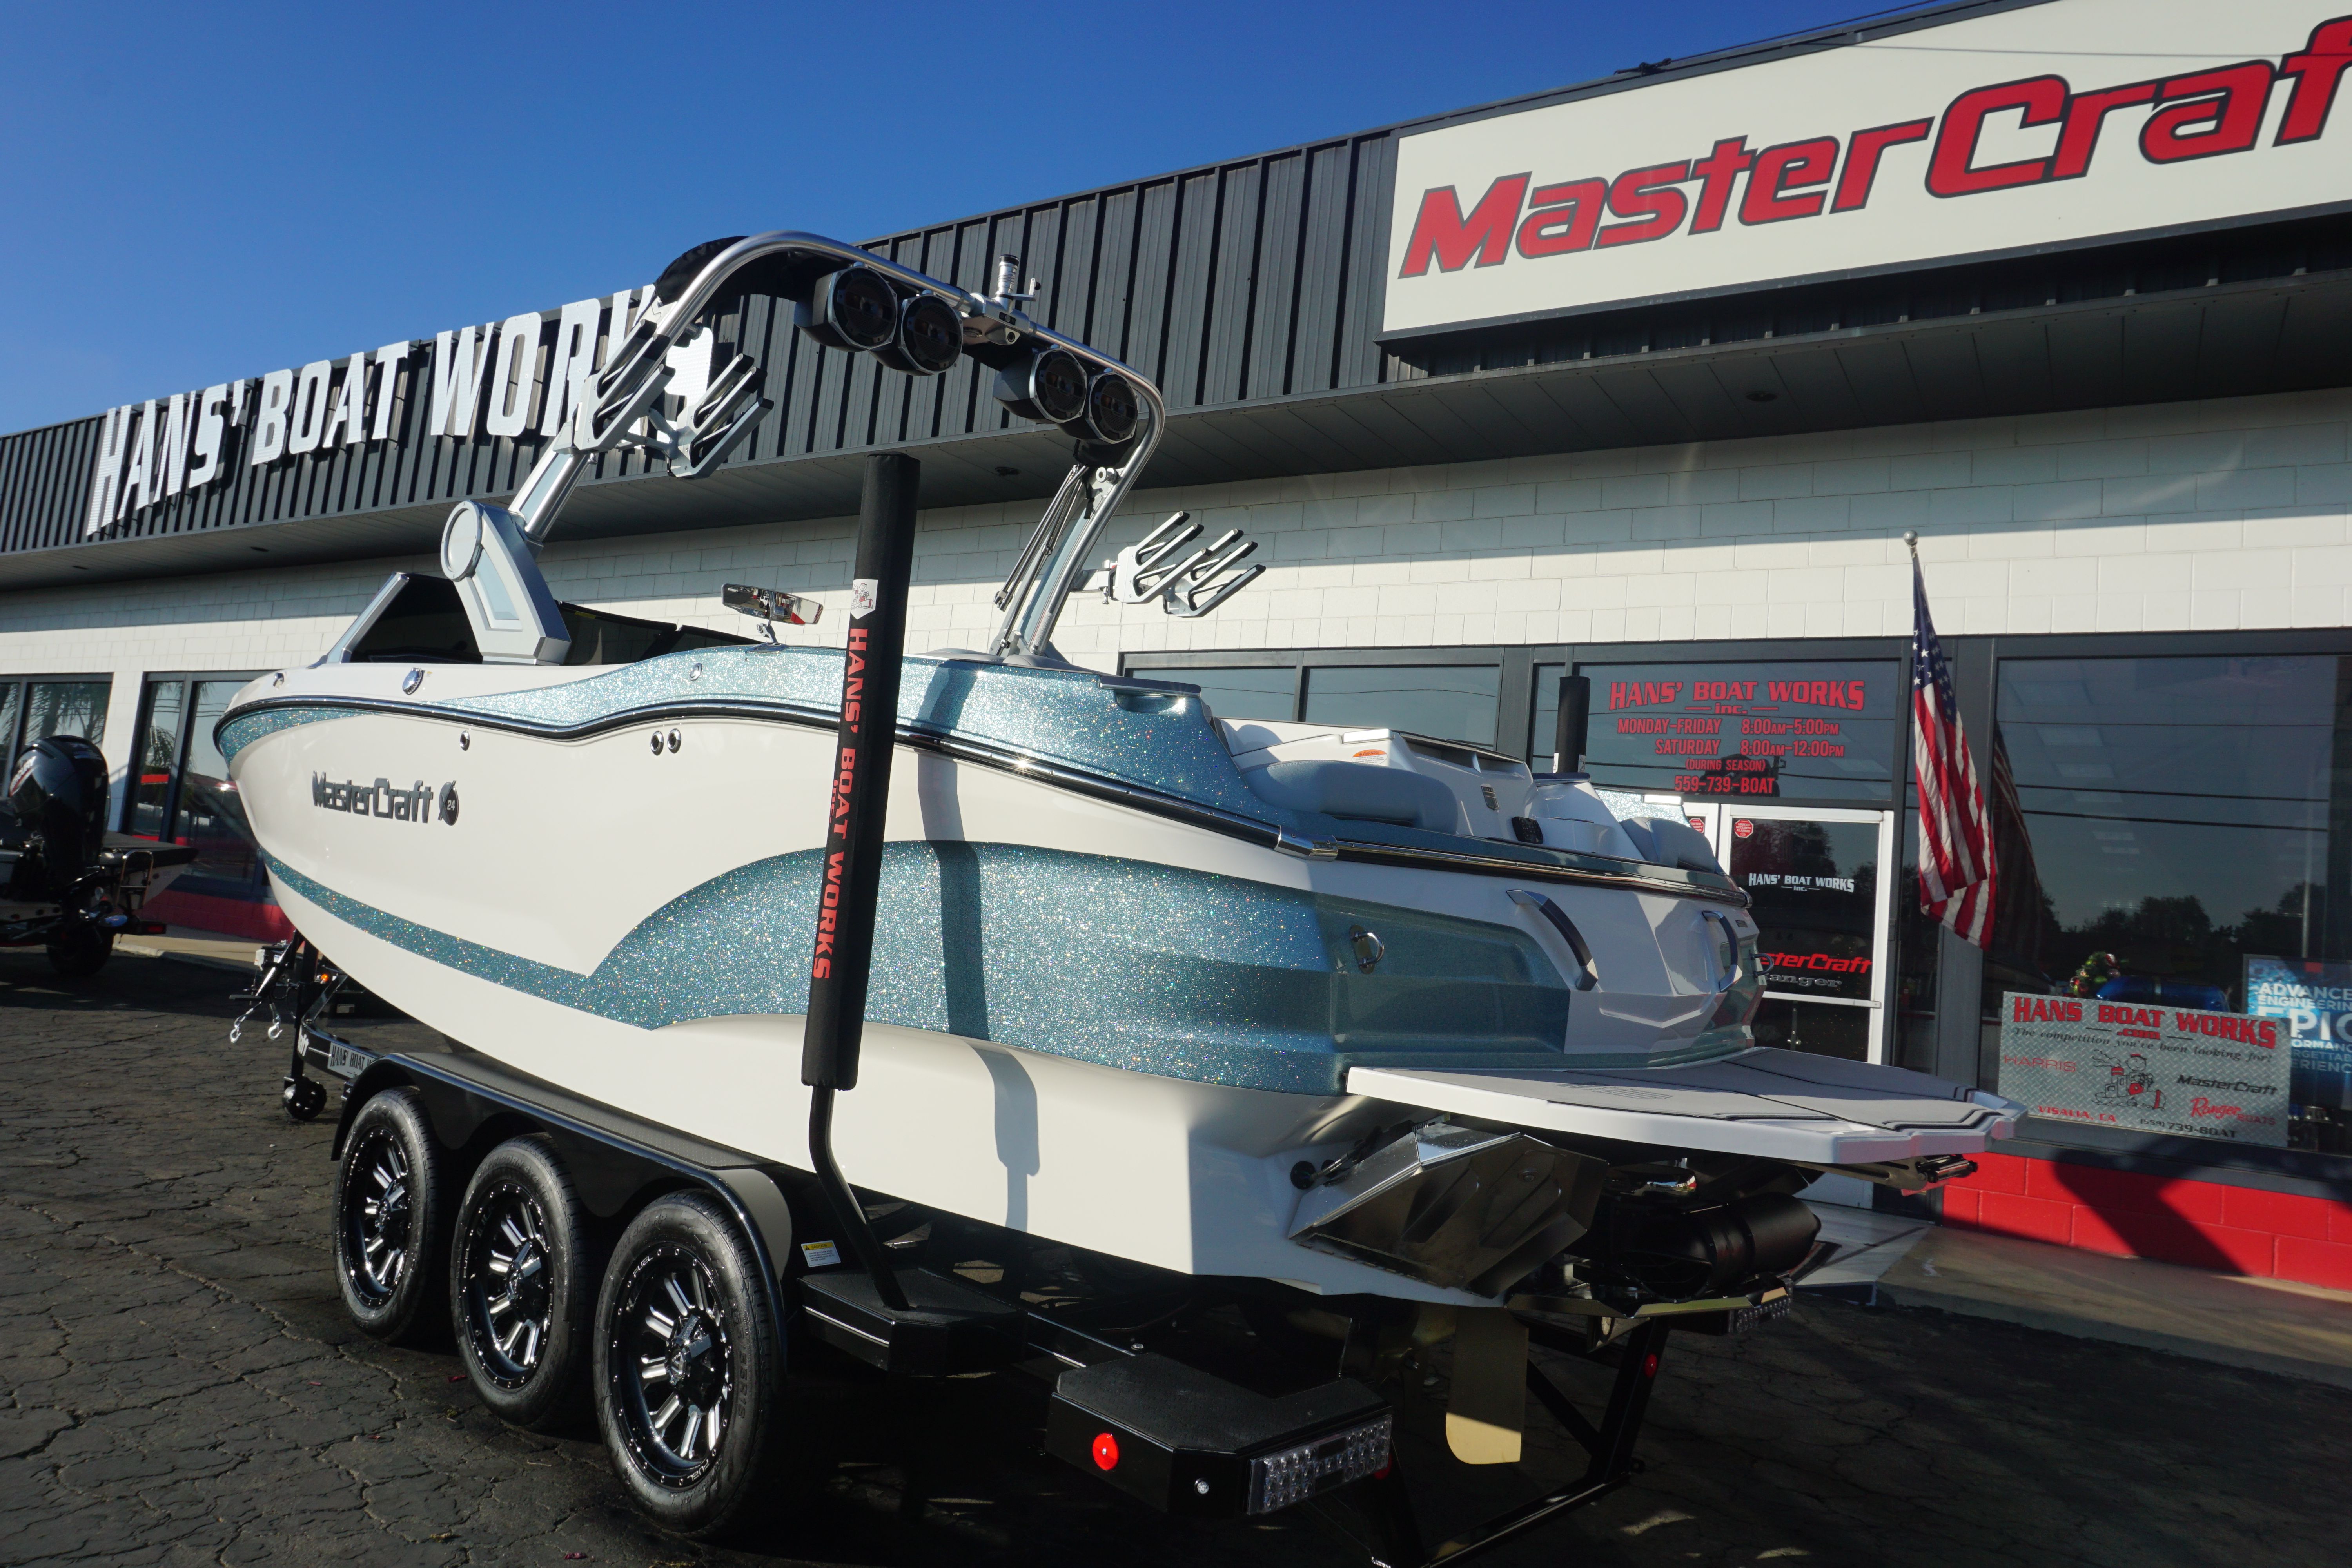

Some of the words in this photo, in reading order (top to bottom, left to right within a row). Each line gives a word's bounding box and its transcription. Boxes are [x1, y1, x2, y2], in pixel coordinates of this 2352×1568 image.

[85, 379, 245, 536] HANS'
[251, 341, 410, 466] BOAT
[844, 627, 868, 733] HANS'
[1609, 681, 1682, 711] HANS'
[1693, 681, 1758, 702] BOAT
[1768, 681, 1865, 711] WORKS
[1617, 718, 1722, 735] MONDAY-FRIDAY
[1741, 719, 1840, 735] 8:00AM-5:00PM
[1655, 739, 1720, 755] SATURDAY
[1740, 739, 1844, 757] 8:00AM-12:00PM
[1685, 758, 1722, 771] (DURING
[1726, 759, 1766, 771] SEASON)
[832, 748, 856, 839] BOAT
[1674, 776, 1775, 793] 559-739-BOAT
[312, 770, 434, 824] MasterCraft
[1749, 873, 1780, 886] HANS'
[1784, 875, 1812, 886] BOAT
[1815, 877, 1854, 893] WORKS
[813, 852, 844, 979] WORKS
[2013, 996, 2082, 1022] HANS
[2098, 1005, 2165, 1028] BOAT
[2176, 1012, 2276, 1049] WORKS
[2014, 1027, 2036, 1037] The
[2040, 1030, 2110, 1044] competition
[2159, 1043, 2187, 1054] been
[2194, 1047, 2241, 1061] looking
[2117, 1028, 2161, 1040] .com
[350, 1052, 365, 1071] BOAT
[2004, 1055, 2076, 1072] HARRIS
[2176, 1074, 2278, 1095] MasterCraft
[2038, 1105, 2094, 1120] VISALIA,
[2099, 1114, 2117, 1122] CA
[2190, 1097, 2242, 1120] Ranger
[2236, 1113, 2276, 1125] BOATS
[2141, 1118, 2165, 1127] (559)
[2167, 1122, 2238, 1138] 739-BOAT
[633, 1255, 653, 1278] FUEL
[687, 1459, 710, 1481] FUEL
